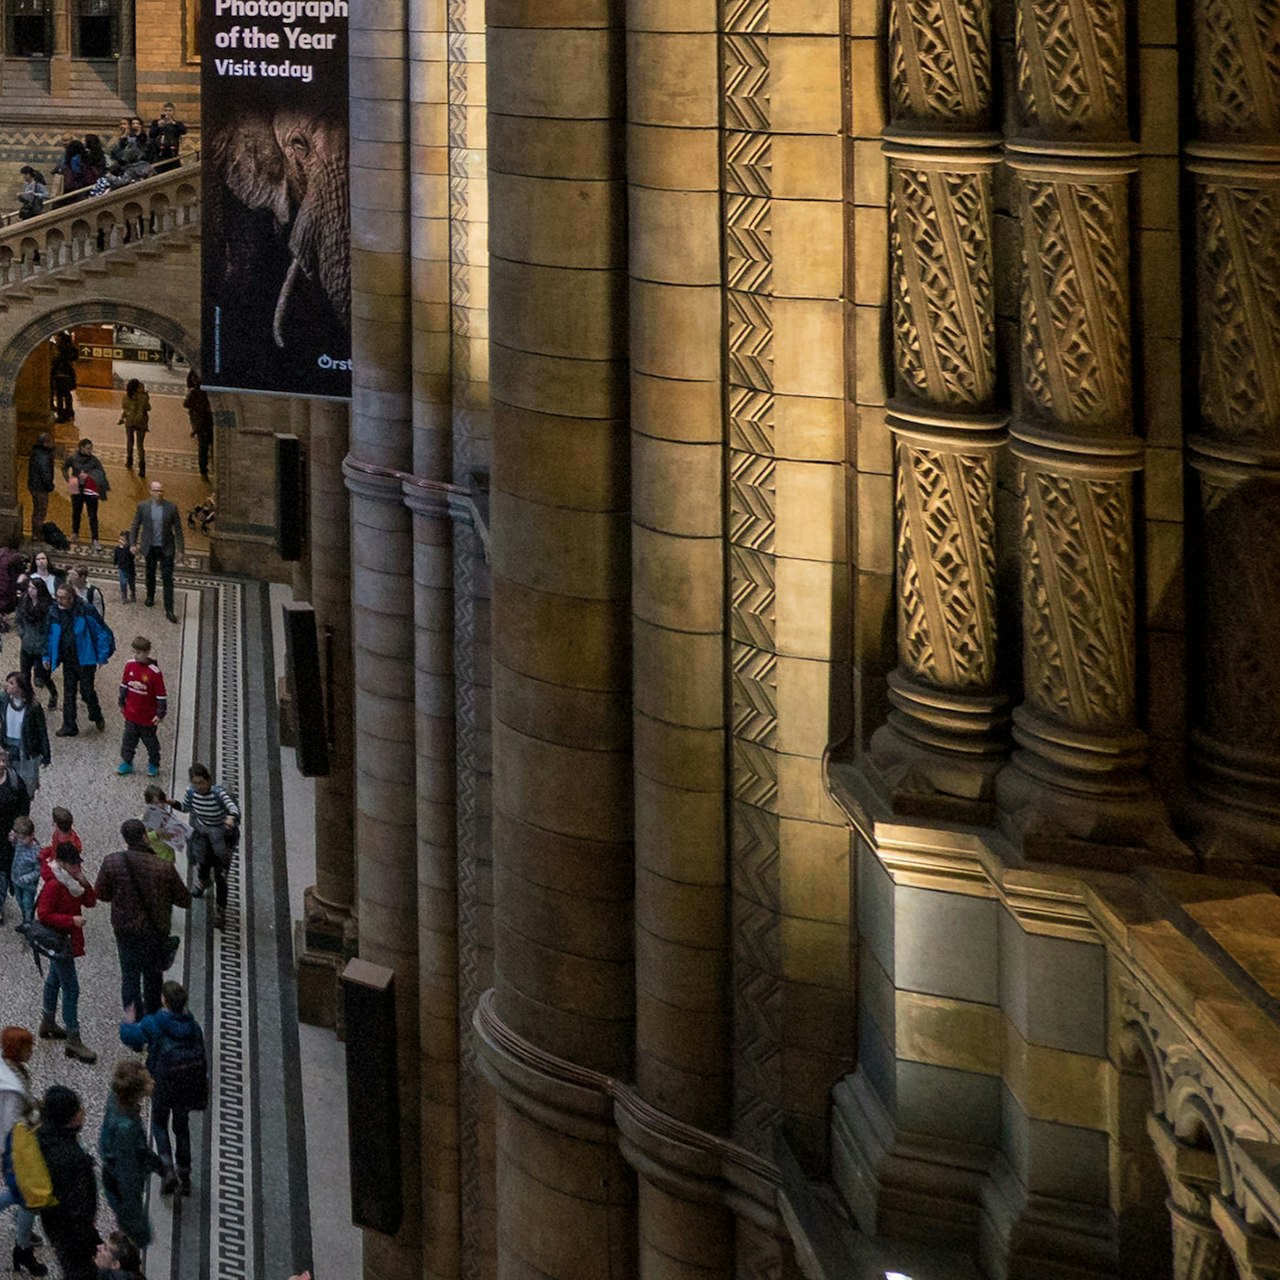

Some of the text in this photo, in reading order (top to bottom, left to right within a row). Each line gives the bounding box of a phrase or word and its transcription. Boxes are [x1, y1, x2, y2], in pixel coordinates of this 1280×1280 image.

[215, 26, 336, 50] of the Year
[214, 59, 313, 83] Visit today
